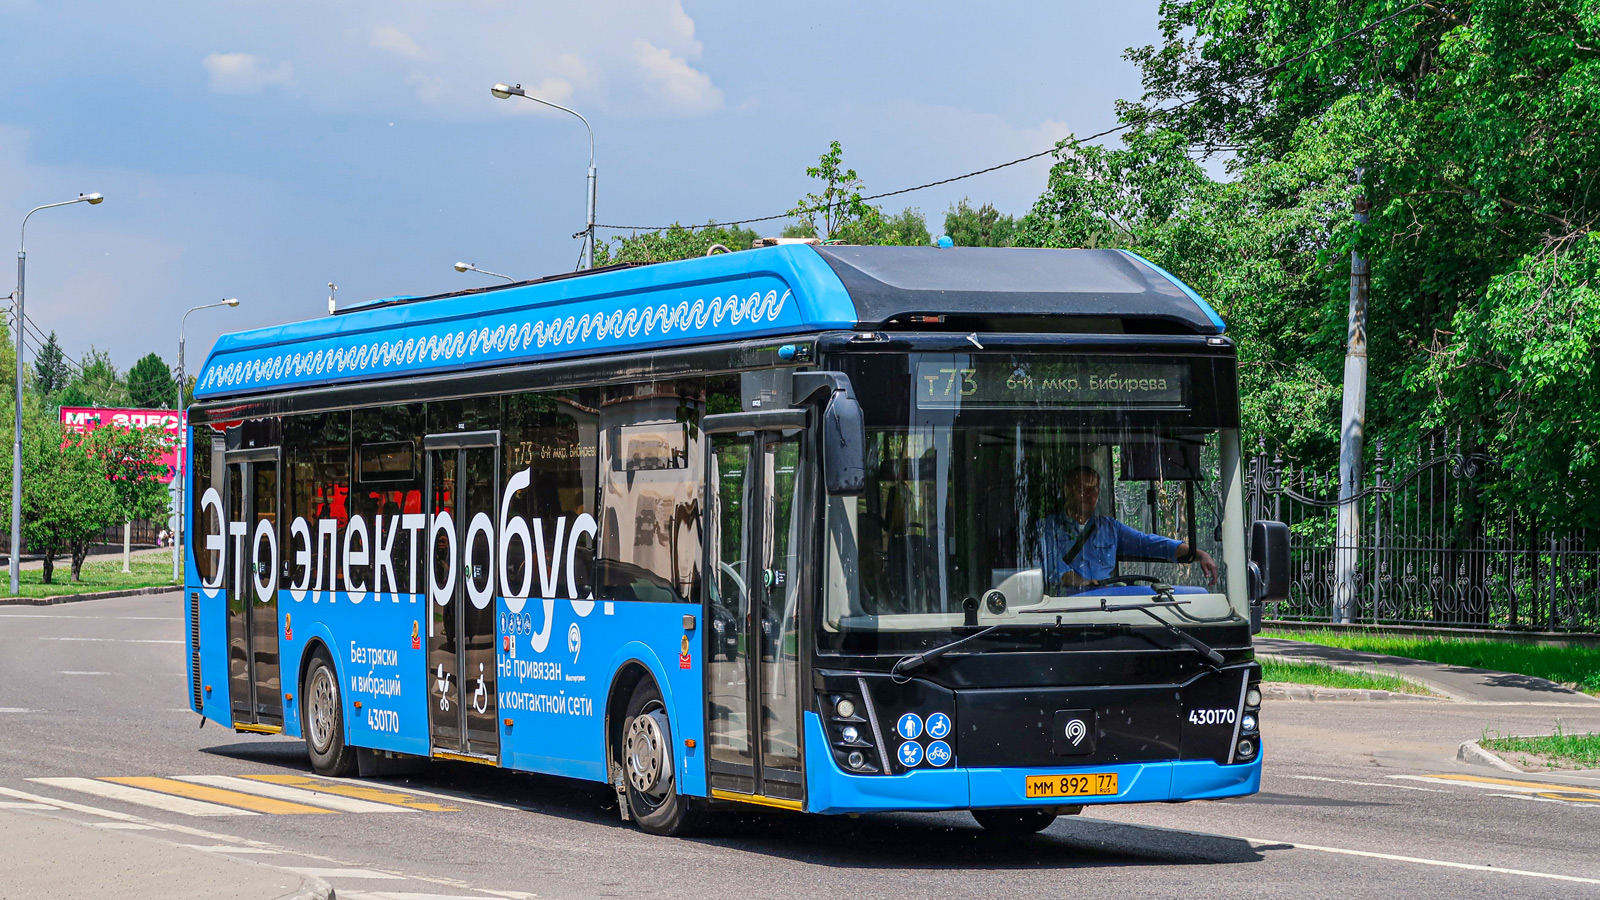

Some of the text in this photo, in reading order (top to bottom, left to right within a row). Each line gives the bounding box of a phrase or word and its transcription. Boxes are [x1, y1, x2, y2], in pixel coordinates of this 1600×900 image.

[1006, 374, 1033, 391] 6-й
[1042, 376, 1082, 393] мкр.
[1089, 373, 1168, 393] Бибирева
[200, 468, 616, 654] Это электробус.
[350, 640, 398, 670] Без тряски
[497, 653, 562, 684] Не привязан
[351, 670, 401, 699] и вибраций
[499, 689, 593, 717] к контактной сети
[1188, 708, 1235, 726] 430170
[367, 708, 400, 734] 430170
[1059, 777, 1089, 794] 892
[1097, 775, 1113, 788] 77
